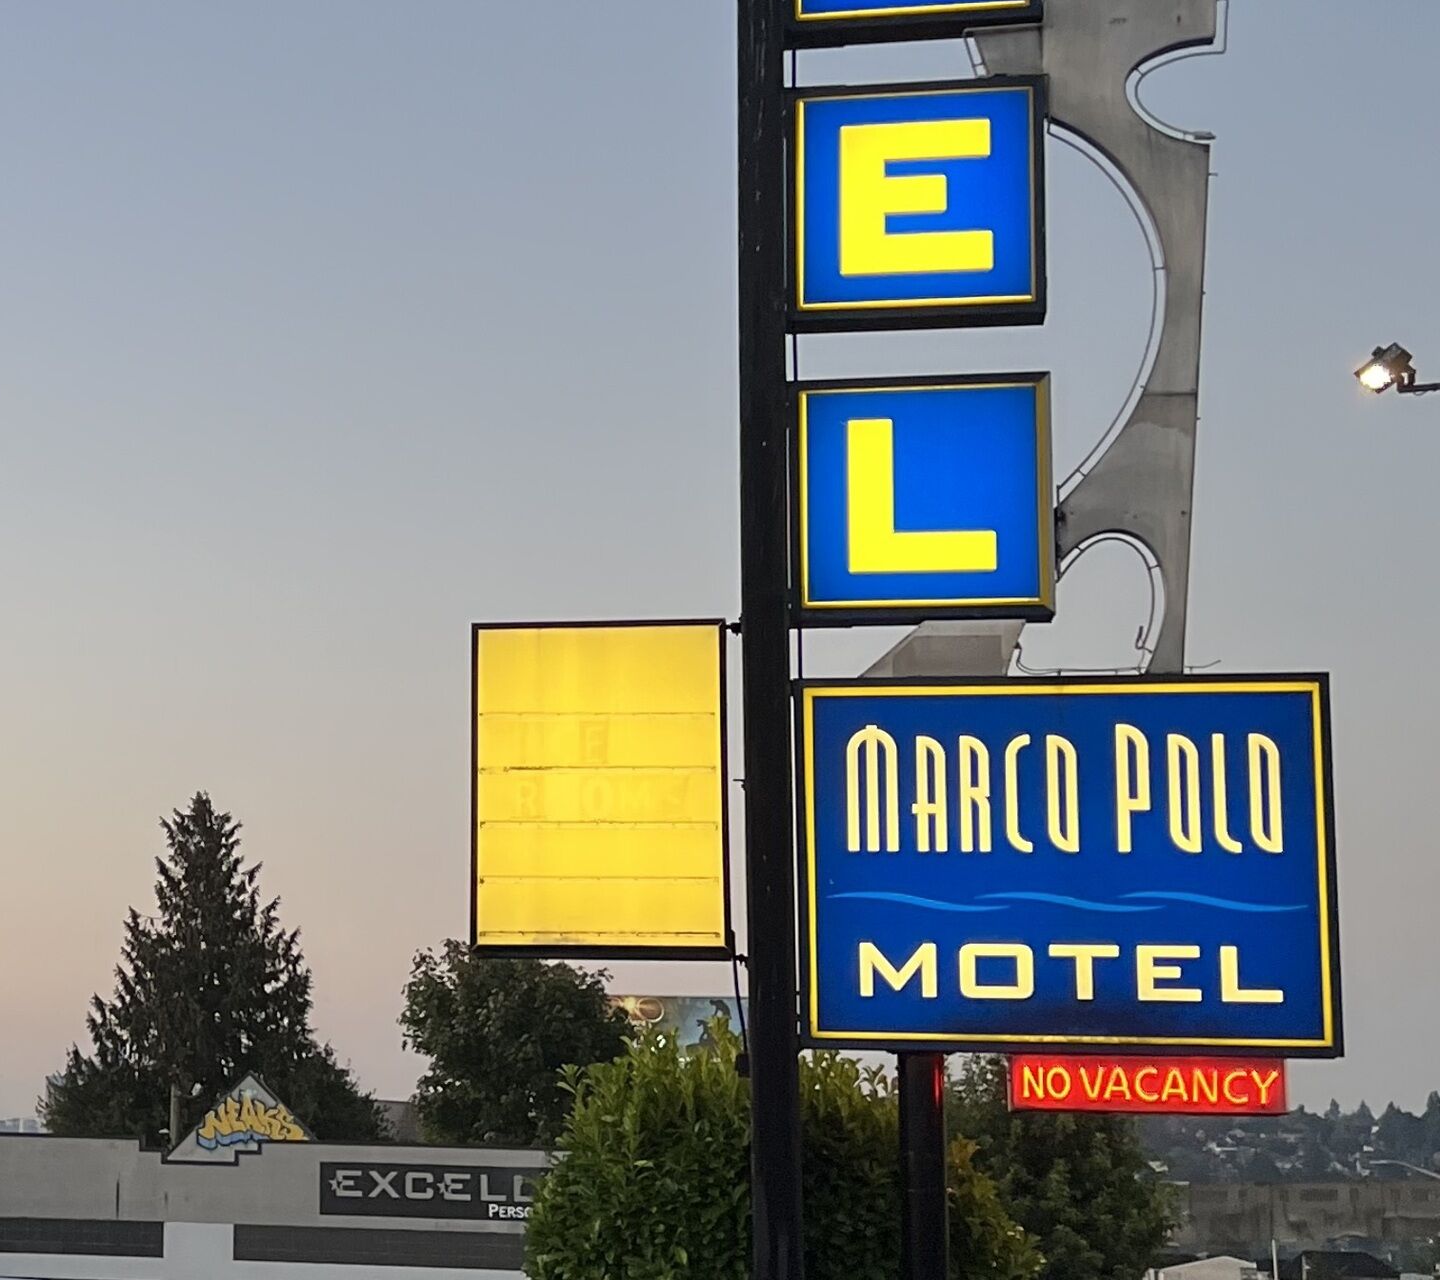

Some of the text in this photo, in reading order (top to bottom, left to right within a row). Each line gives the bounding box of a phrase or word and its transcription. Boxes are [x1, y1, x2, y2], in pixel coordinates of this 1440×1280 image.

[846, 723, 1284, 854] MARCO POLO
[858, 941, 1284, 1003] MOTEL
[1022, 1065, 1280, 1105] NO VACANCY
